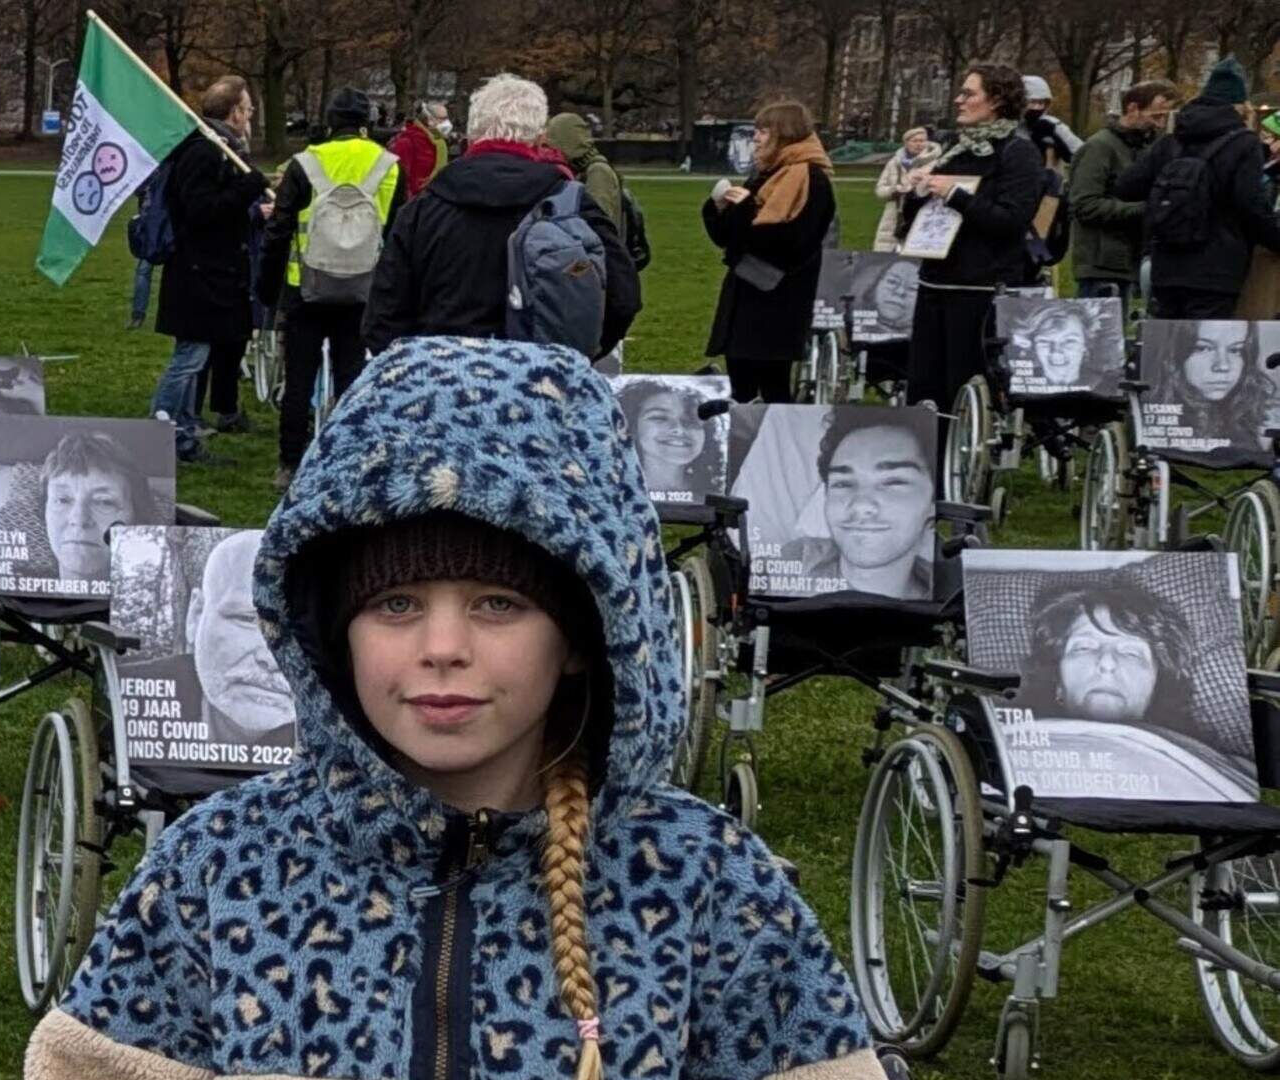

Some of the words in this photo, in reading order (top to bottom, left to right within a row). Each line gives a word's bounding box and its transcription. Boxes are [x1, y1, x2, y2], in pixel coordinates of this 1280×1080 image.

[1156, 415, 1179, 425] JAAR
[1167, 426, 1193, 437] COVID
[0, 546, 29, 560] JAAR
[766, 559, 802, 575] COVID
[18, 577, 89, 593] SEPTEMBER
[770, 576, 813, 591] MAART
[142, 700, 181, 718] JAAR
[995, 708, 1035, 726] ETRA
[127, 720, 159, 738] ONG
[162, 721, 209, 740] COVID
[1012, 730, 1051, 747] JAAR
[128, 741, 165, 760] INDS
[168, 743, 248, 763] AUGUSTUS
[251, 745, 293, 765] 2022
[1089, 752, 1114, 770] ME
[1043, 771, 1114, 791] OKTOBER
[1121, 774, 1161, 793] 2021
